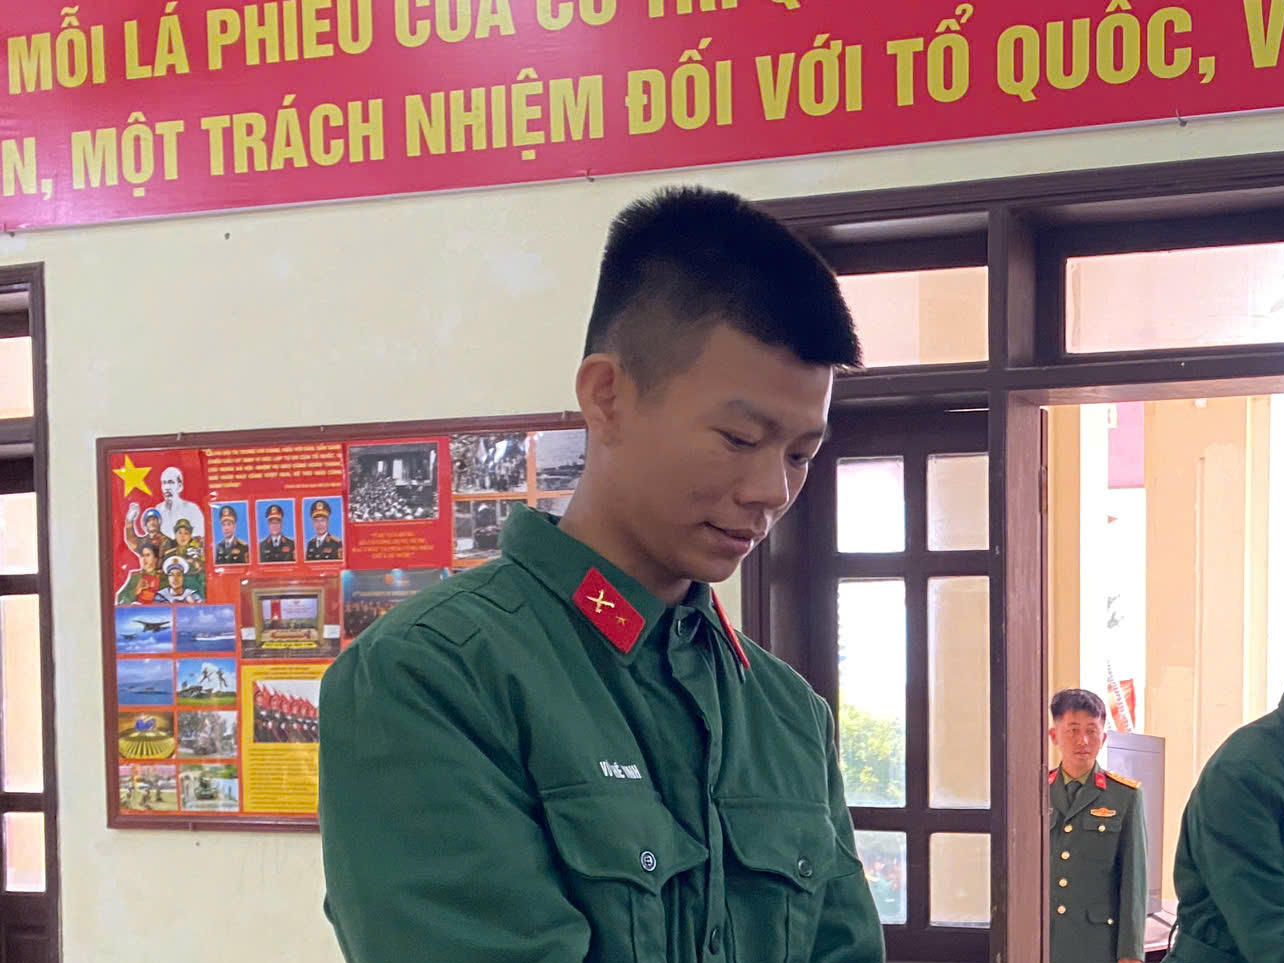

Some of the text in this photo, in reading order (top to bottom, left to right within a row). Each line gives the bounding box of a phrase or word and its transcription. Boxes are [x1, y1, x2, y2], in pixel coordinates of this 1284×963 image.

[8, 5, 106, 95] MỖI
[124, 1, 190, 80] LÁ
[71, 111, 185, 197] MỘT
[200, 94, 385, 176] TRÁCH
[405, 68, 604, 172] NHIỆM
[625, 37, 733, 135] ĐỐI
[755, 33, 862, 121] VỚI
[887, 3, 974, 106] TỔ
